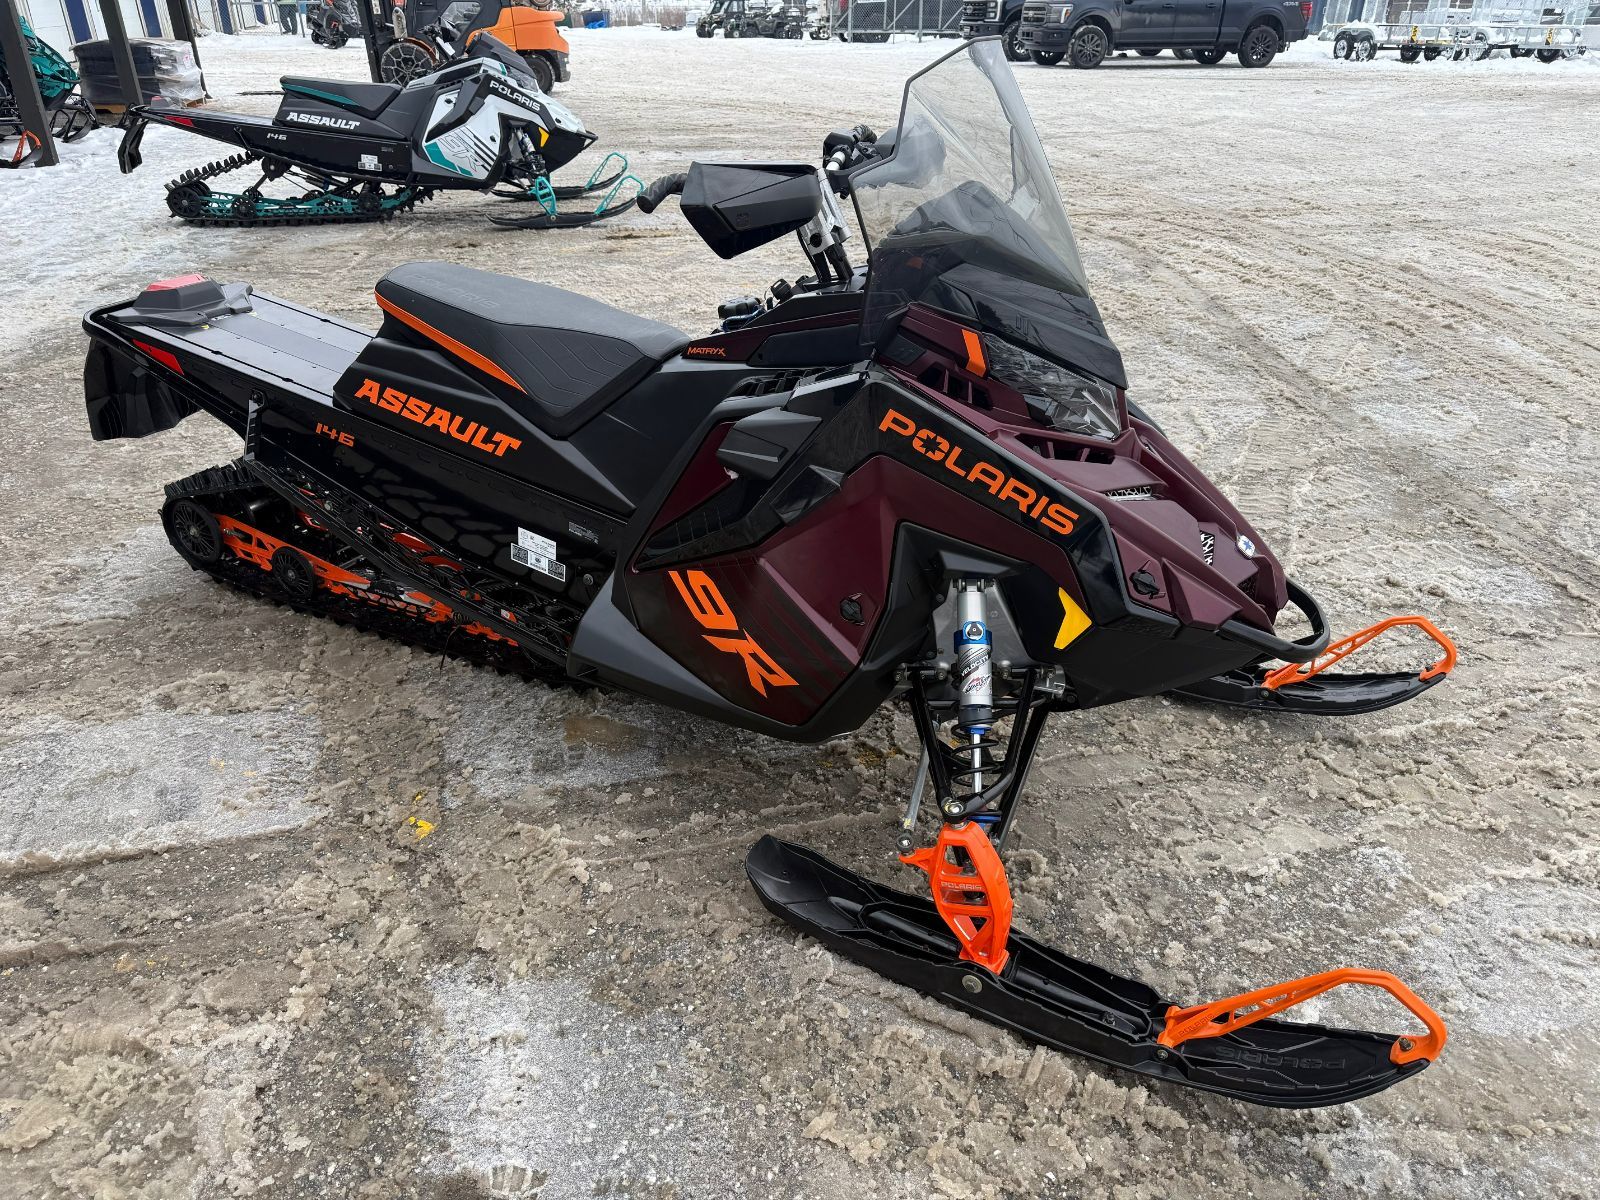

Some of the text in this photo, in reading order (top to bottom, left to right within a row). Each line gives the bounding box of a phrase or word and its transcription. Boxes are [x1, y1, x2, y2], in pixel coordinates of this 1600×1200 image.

[489, 80, 541, 112] POLARIS
[286, 112, 360, 130] ASSAULT
[266, 132, 288, 141] 146
[687, 346, 726, 357] MATRYX
[354, 378, 522, 457] ASSAULT
[315, 422, 355, 447] 146
[879, 408, 1080, 535] POLARIS
[961, 654, 990, 677] VELOCITY
[940, 881, 983, 890] POLARIS
